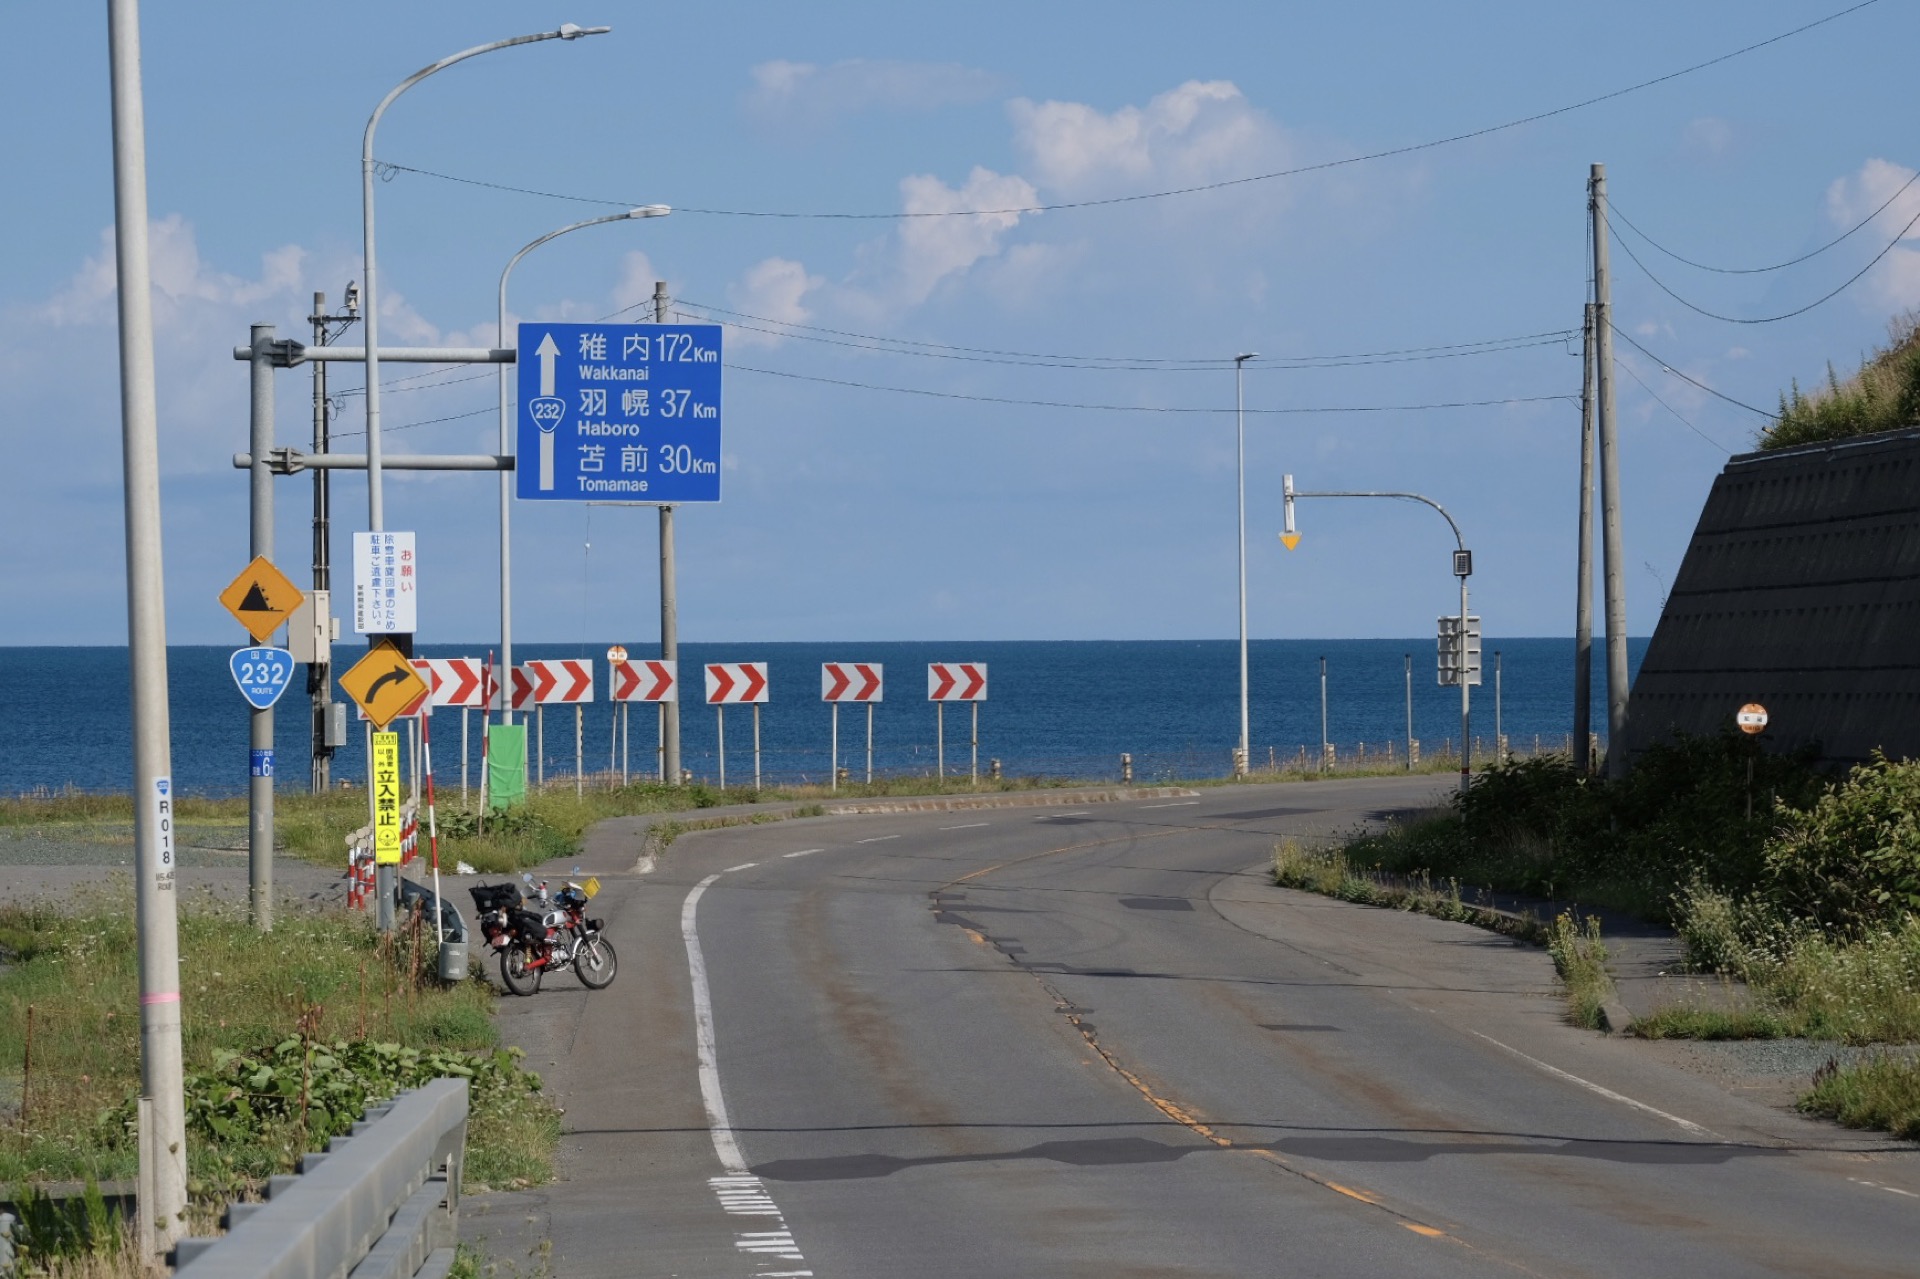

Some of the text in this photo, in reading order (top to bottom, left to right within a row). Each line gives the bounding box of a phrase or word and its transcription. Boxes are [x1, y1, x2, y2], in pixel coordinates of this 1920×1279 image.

[579, 333, 649, 361] 稚内
[578, 365, 649, 380] Wakkanai
[535, 403, 560, 419] 232
[578, 389, 649, 416] 羽幌
[577, 421, 639, 436] Haboro
[577, 444, 648, 472] 苫前
[577, 476, 648, 492] Tomamae
[400, 549, 412, 592] お願い
[250, 651, 274, 660] 国道
[241, 663, 284, 684] 232
[251, 687, 273, 695] ROUTE
[377, 769, 396, 826] 立入禁止
